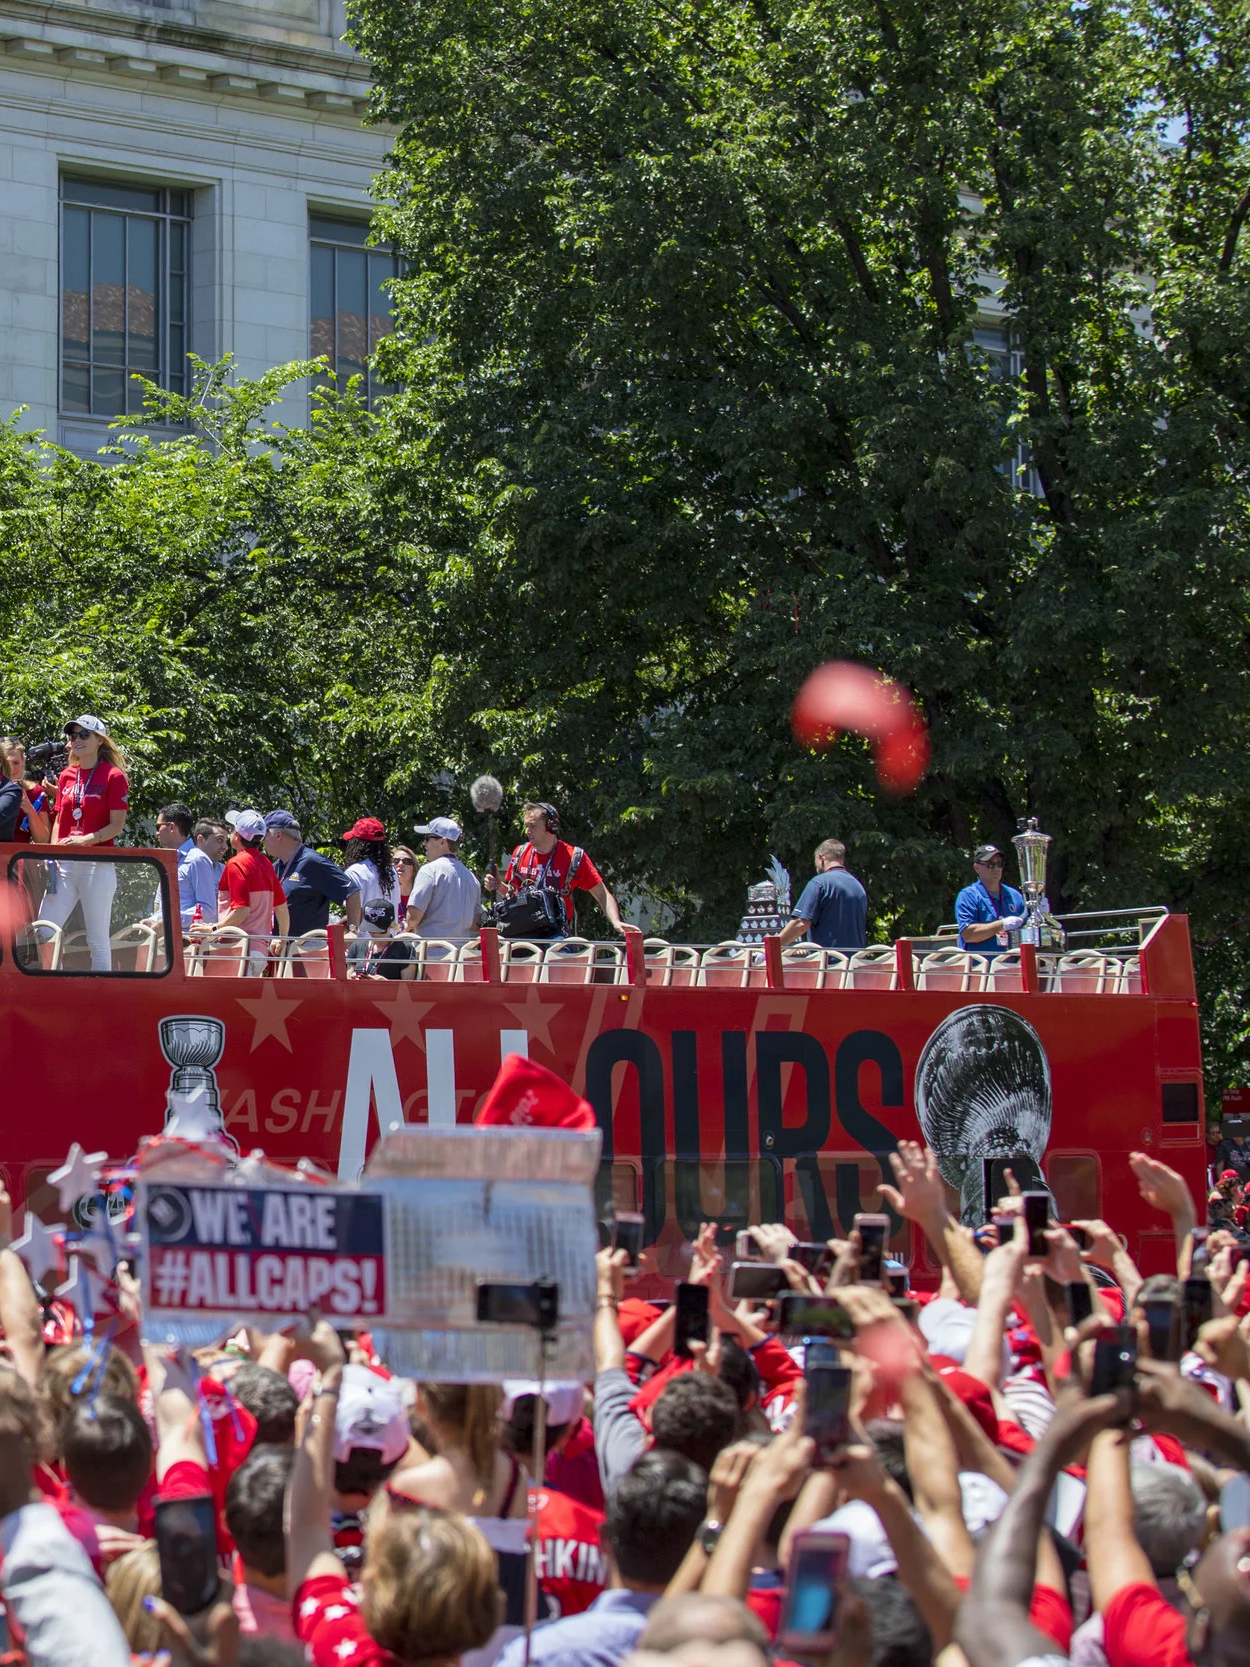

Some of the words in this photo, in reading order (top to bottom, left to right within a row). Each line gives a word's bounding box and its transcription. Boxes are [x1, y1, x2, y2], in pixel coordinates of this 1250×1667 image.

[336, 1028, 528, 1185] AL
[585, 1029, 905, 1246] OURS
[190, 1189, 251, 1246] WE
[262, 1192, 337, 1250] ARE
[154, 1252, 377, 1315] #ALLCAPS!
